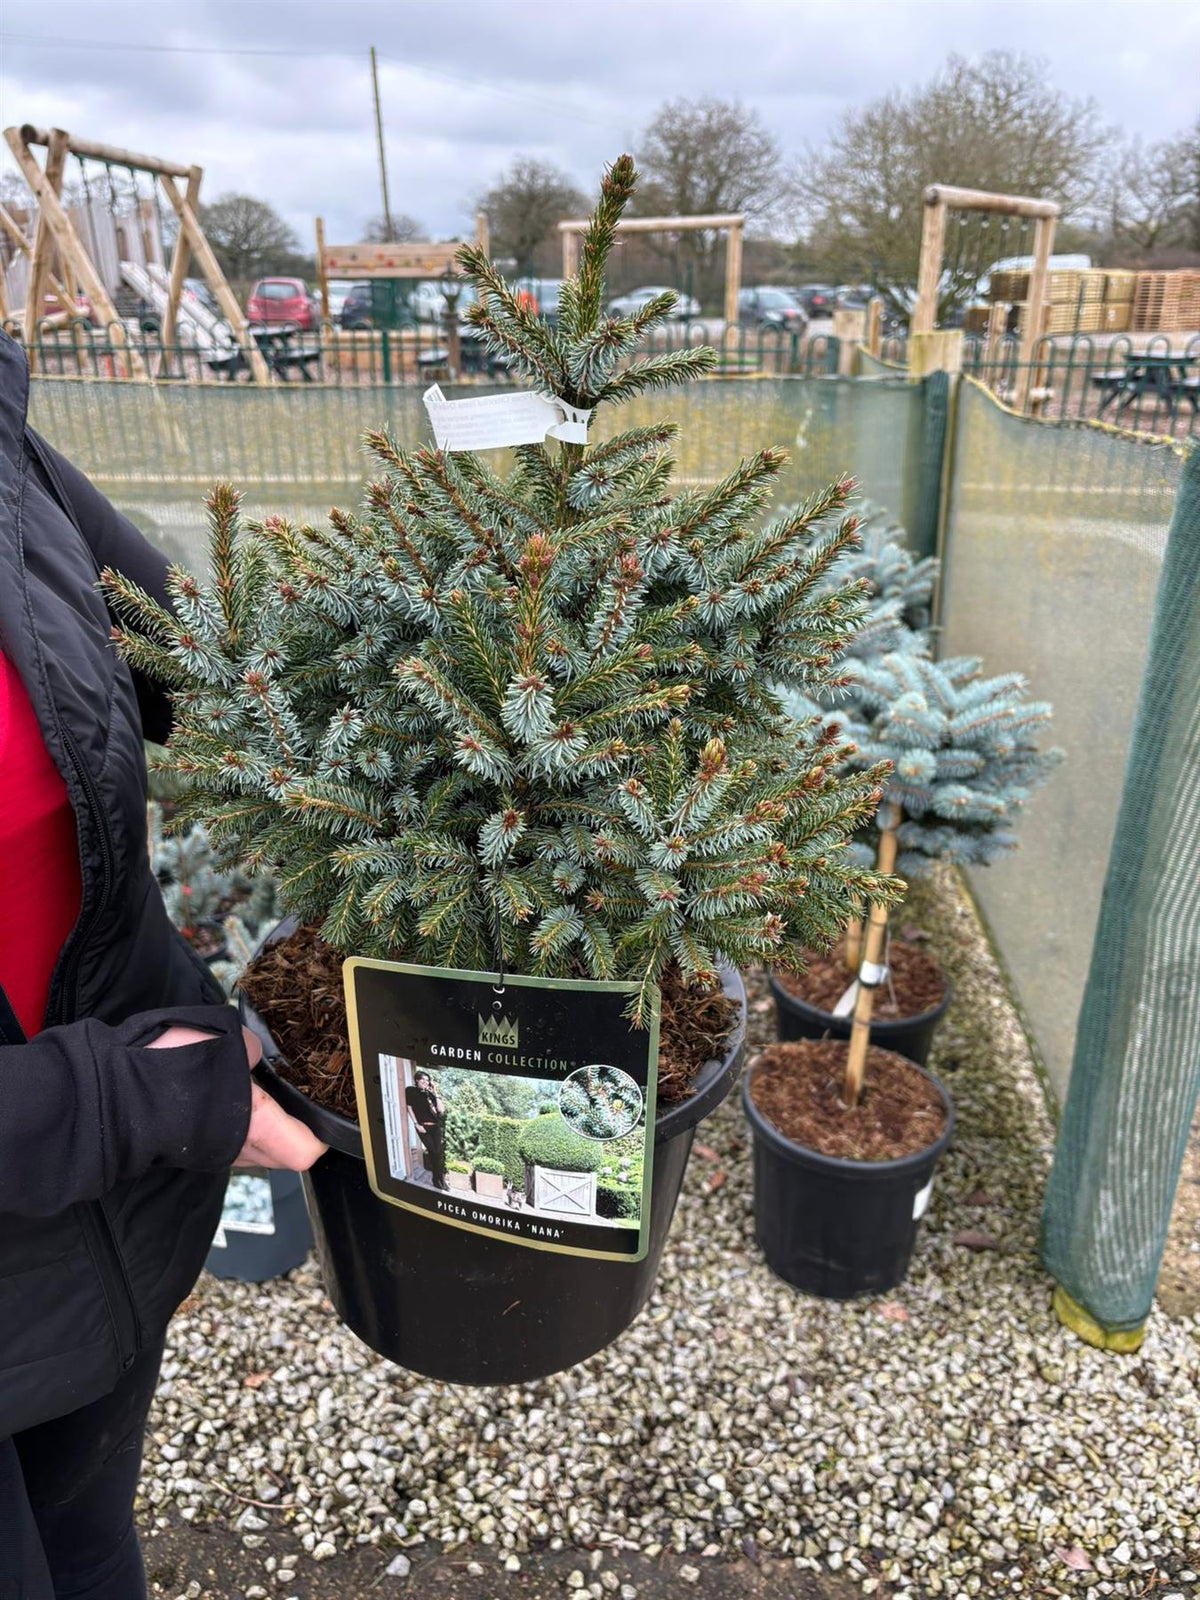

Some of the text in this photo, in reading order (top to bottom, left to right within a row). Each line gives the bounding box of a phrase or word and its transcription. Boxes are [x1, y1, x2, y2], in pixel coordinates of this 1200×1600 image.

[482, 1032, 516, 1046] KINGS
[430, 1044, 567, 1071] GARDEN COLLECTION
[437, 1200, 466, 1217] PICEA
[472, 1211, 520, 1231] OMORIKA
